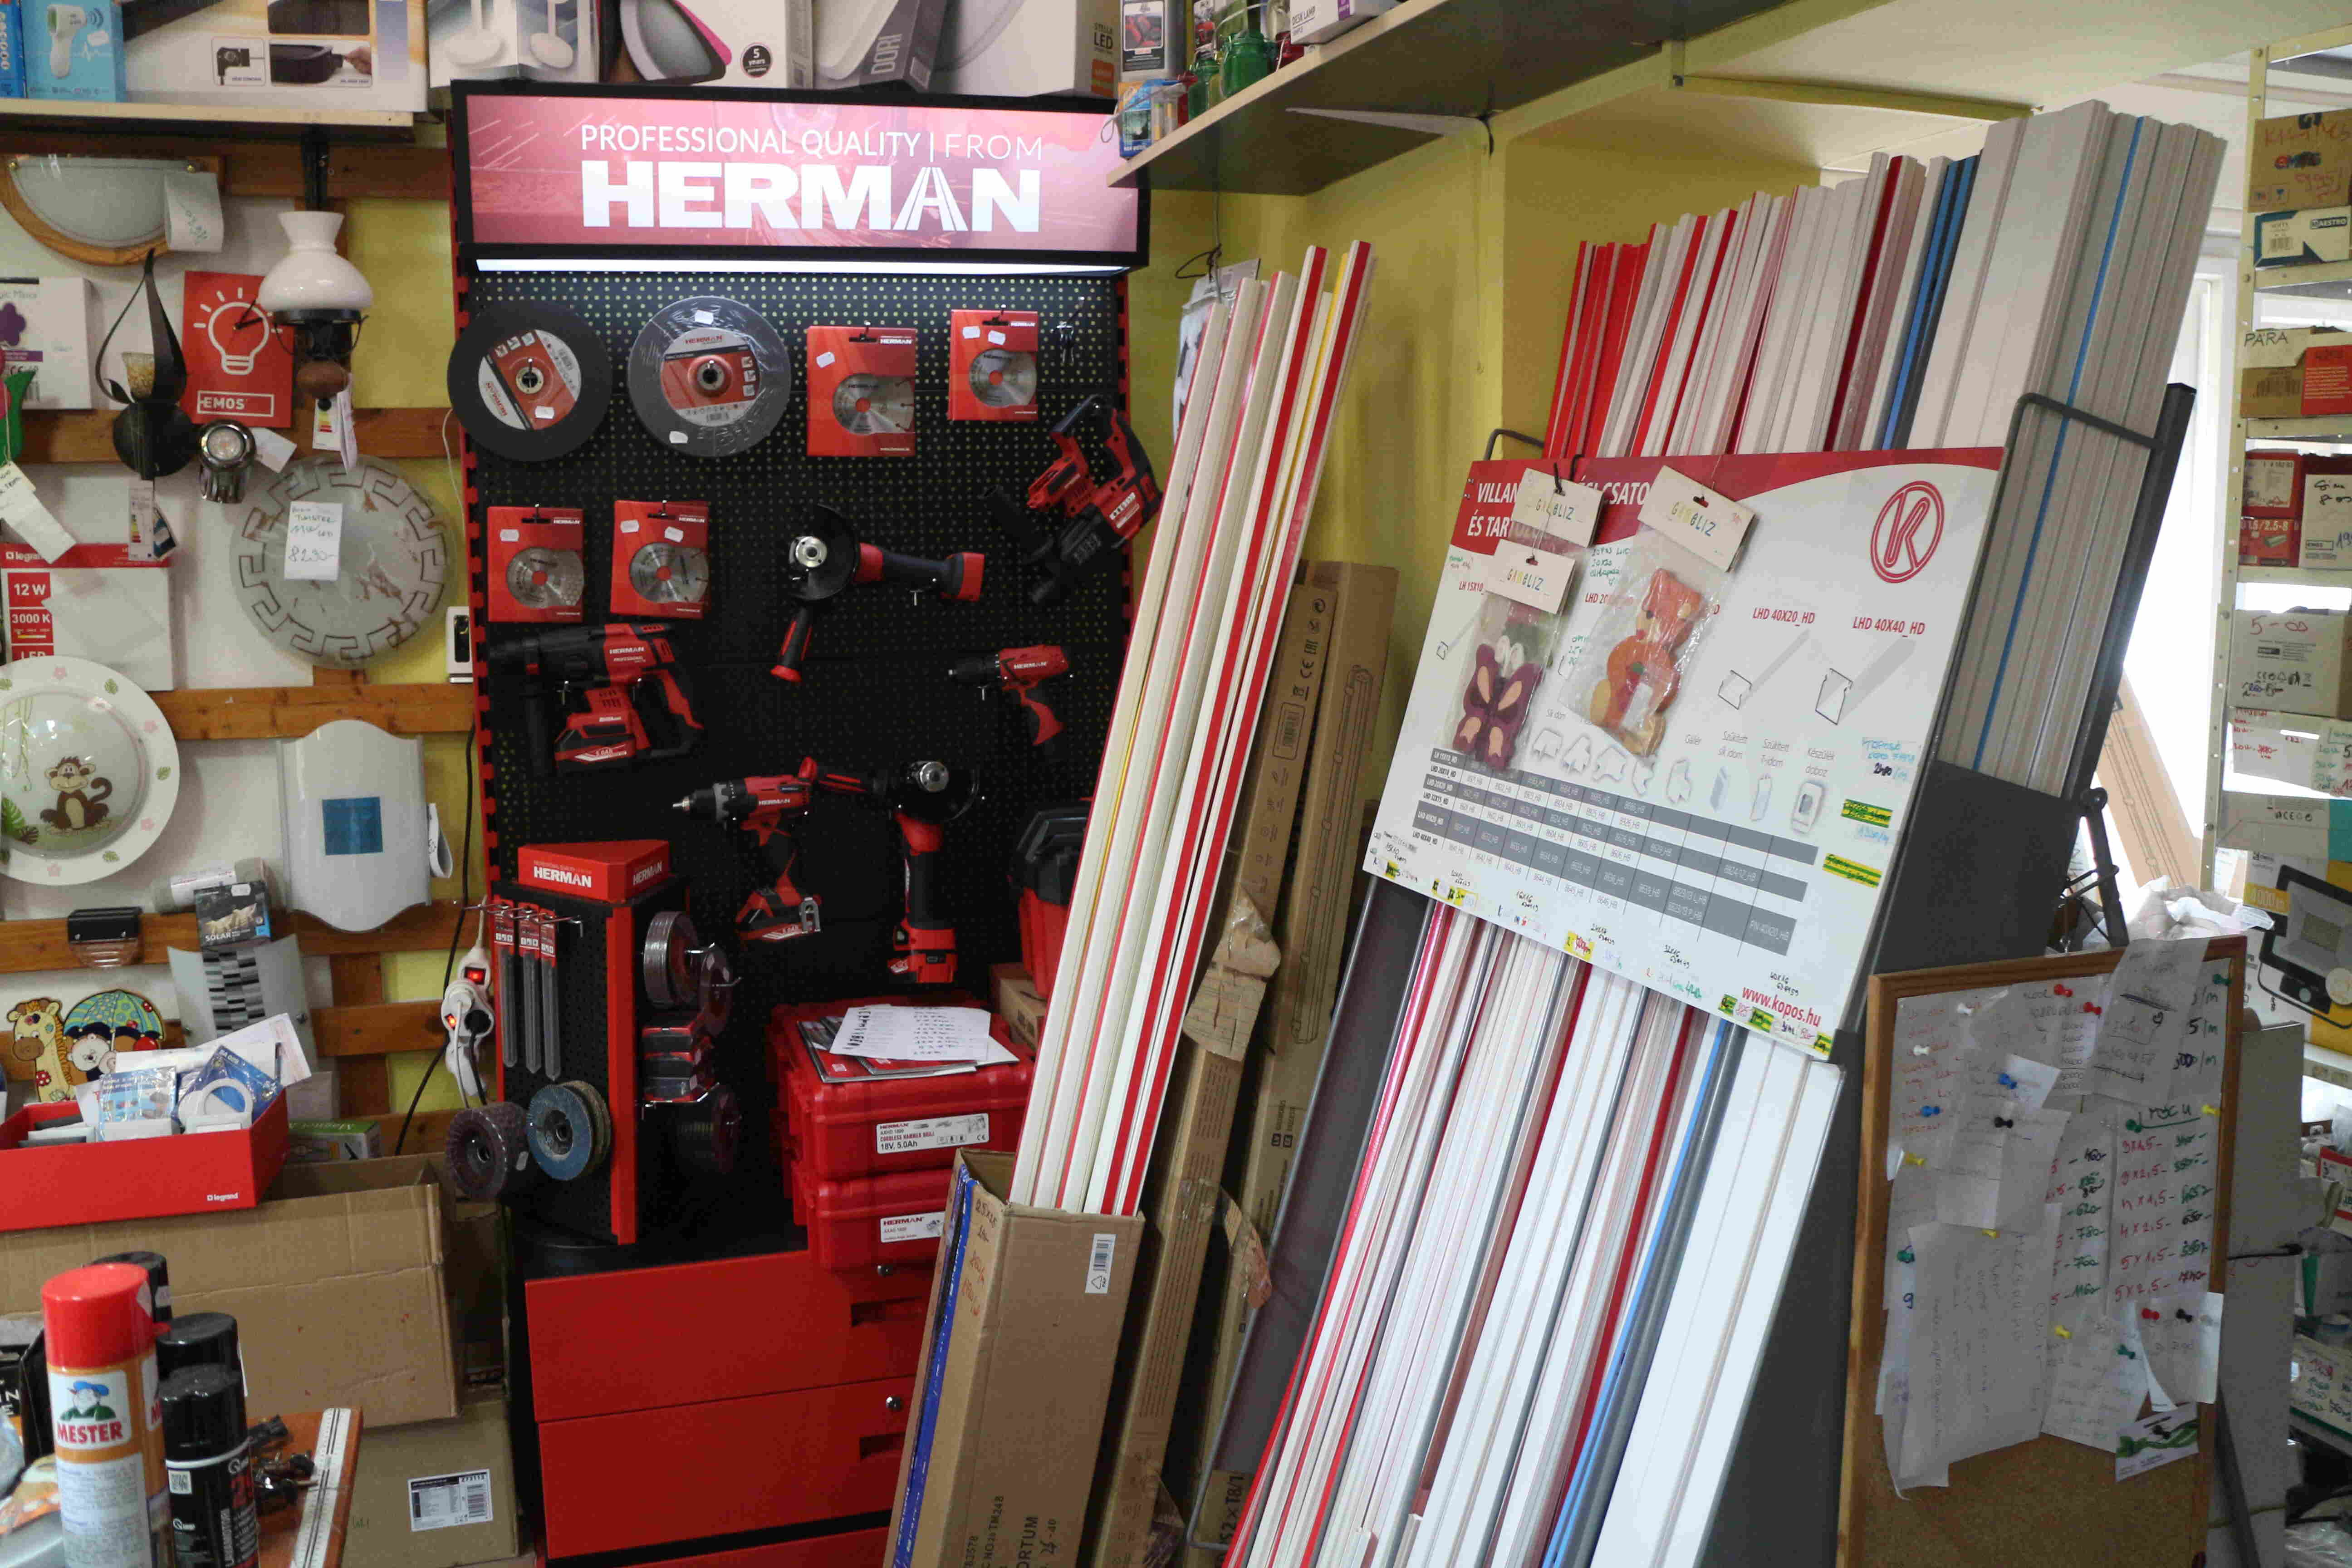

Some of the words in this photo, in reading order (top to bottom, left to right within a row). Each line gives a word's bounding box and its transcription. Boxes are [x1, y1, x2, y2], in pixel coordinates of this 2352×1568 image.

[1094, 31, 1113, 49] LED
[753, 48, 760, 59] 5
[871, 34, 903, 75] DORI
[581, 124, 794, 154] PROFESSIONAL
[801, 130, 921, 157] QUALITY
[946, 134, 1042, 161] FROM
[581, 160, 1040, 232] HERMAN
[880, 338, 913, 346] HERMAN
[203, 396, 245, 411] EMOS
[1467, 509, 1483, 538] ÉS
[14, 583, 29, 596] 12
[31, 583, 46, 596] W
[1466, 582, 1485, 595] 15X10_
[1585, 592, 1597, 603] LHD
[12, 613, 39, 624] 3000
[42, 613, 51, 623] K
[1752, 607, 1770, 620] LHD
[1771, 609, 1815, 627] 40X20_HD
[1852, 617, 1873, 631] LHD
[1874, 618, 1926, 637] 40X40_HD
[608, 646, 645, 655] HERMAN
[1013, 661, 1047, 671] HERMAN
[1805, 764, 1828, 778] doboz
[758, 798, 791, 806] HERMAN
[533, 865, 592, 888] HERMAN
[632, 861, 663, 886] HERMAN
[205, 932, 232, 942] SOLAR
[1741, 986, 1822, 1028] www.kopos.hu
[881, 1142, 896, 1151] 18V,
[897, 1140, 918, 1149] 5.0Ah
[213, 1192, 239, 1202] legrand
[883, 1217, 923, 1226] HERMAN
[56, 1421, 124, 1444] MESTER
